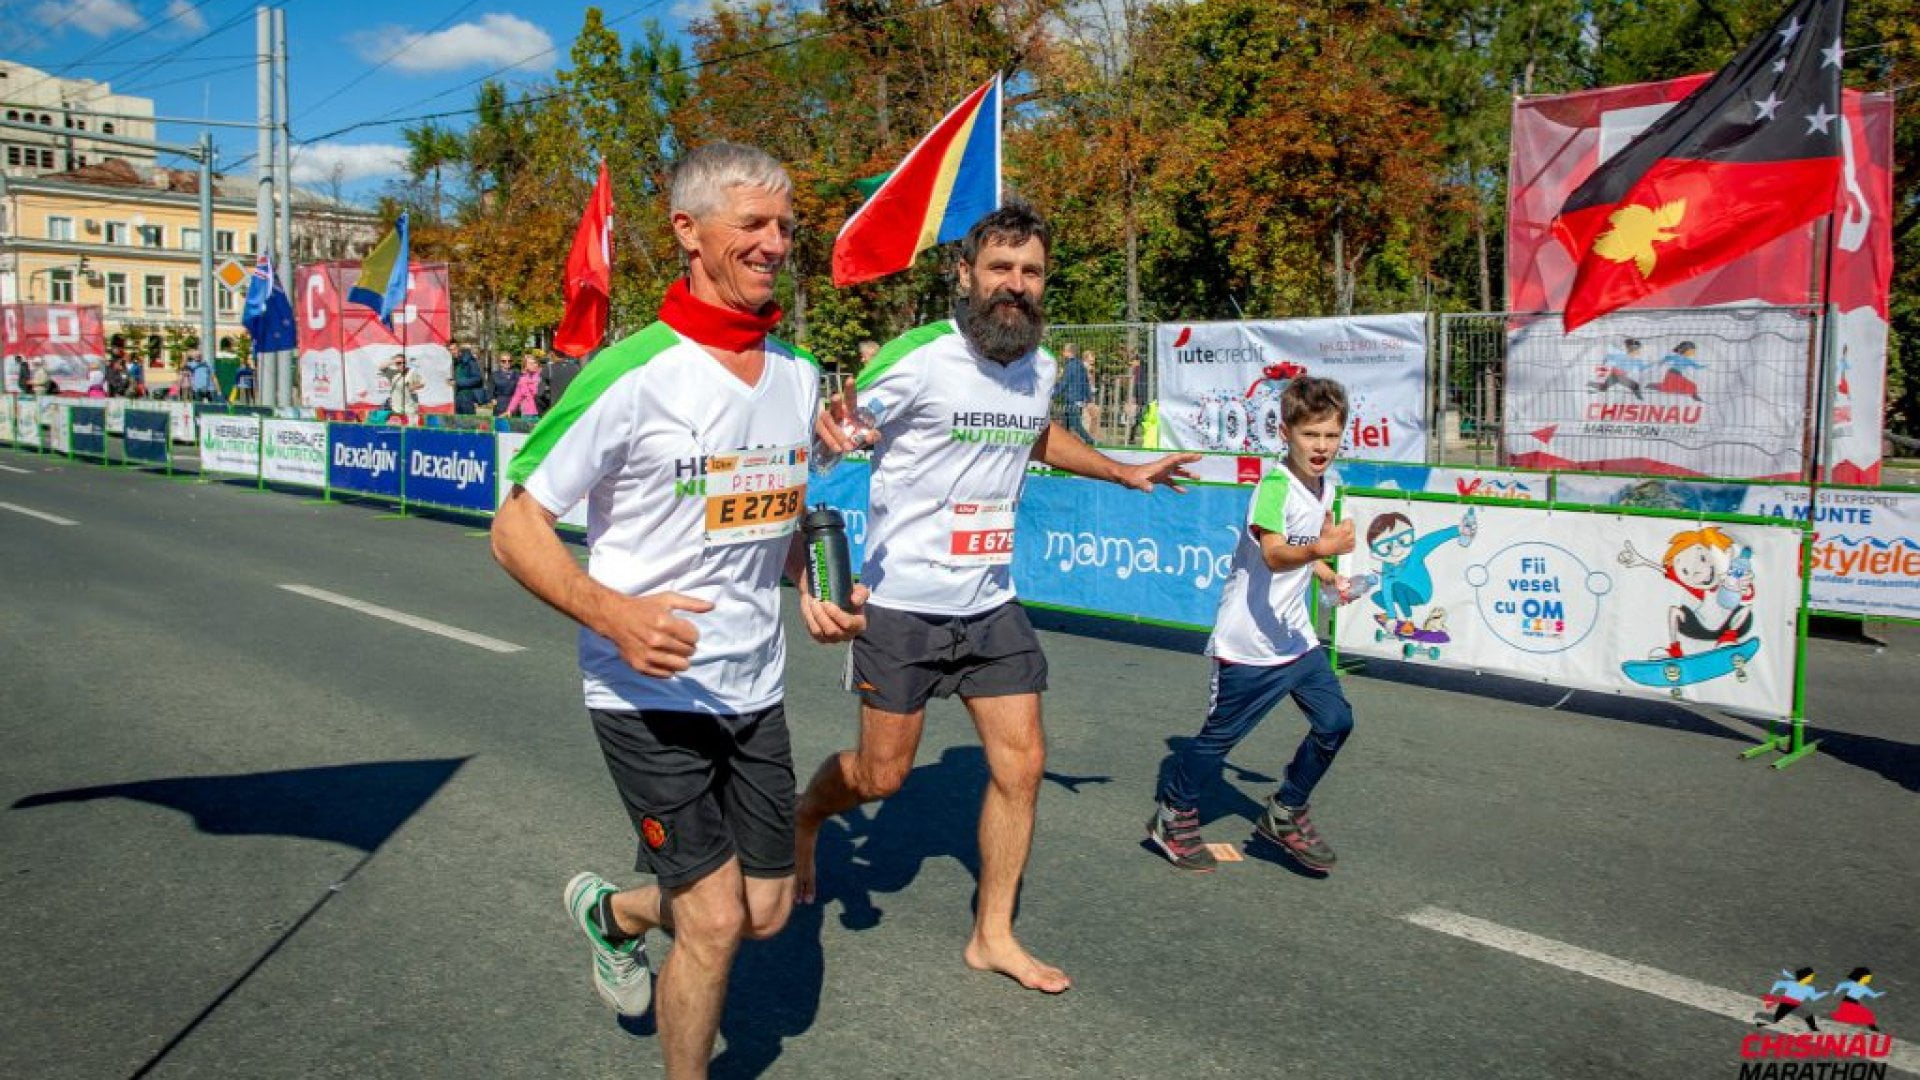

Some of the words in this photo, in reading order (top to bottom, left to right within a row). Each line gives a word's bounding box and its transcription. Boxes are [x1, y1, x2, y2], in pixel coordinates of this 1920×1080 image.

[1586, 403, 1703, 423] CHISINAU
[952, 429, 1036, 445] NUTRITIO
[1351, 418, 1389, 446] lei
[720, 499, 736, 523] E
[743, 490, 799, 520] 2738
[1521, 558, 1546, 575] Fii
[1508, 577, 1560, 593] vesel
[1494, 601, 1516, 614] cu
[1522, 599, 1564, 620] OM
